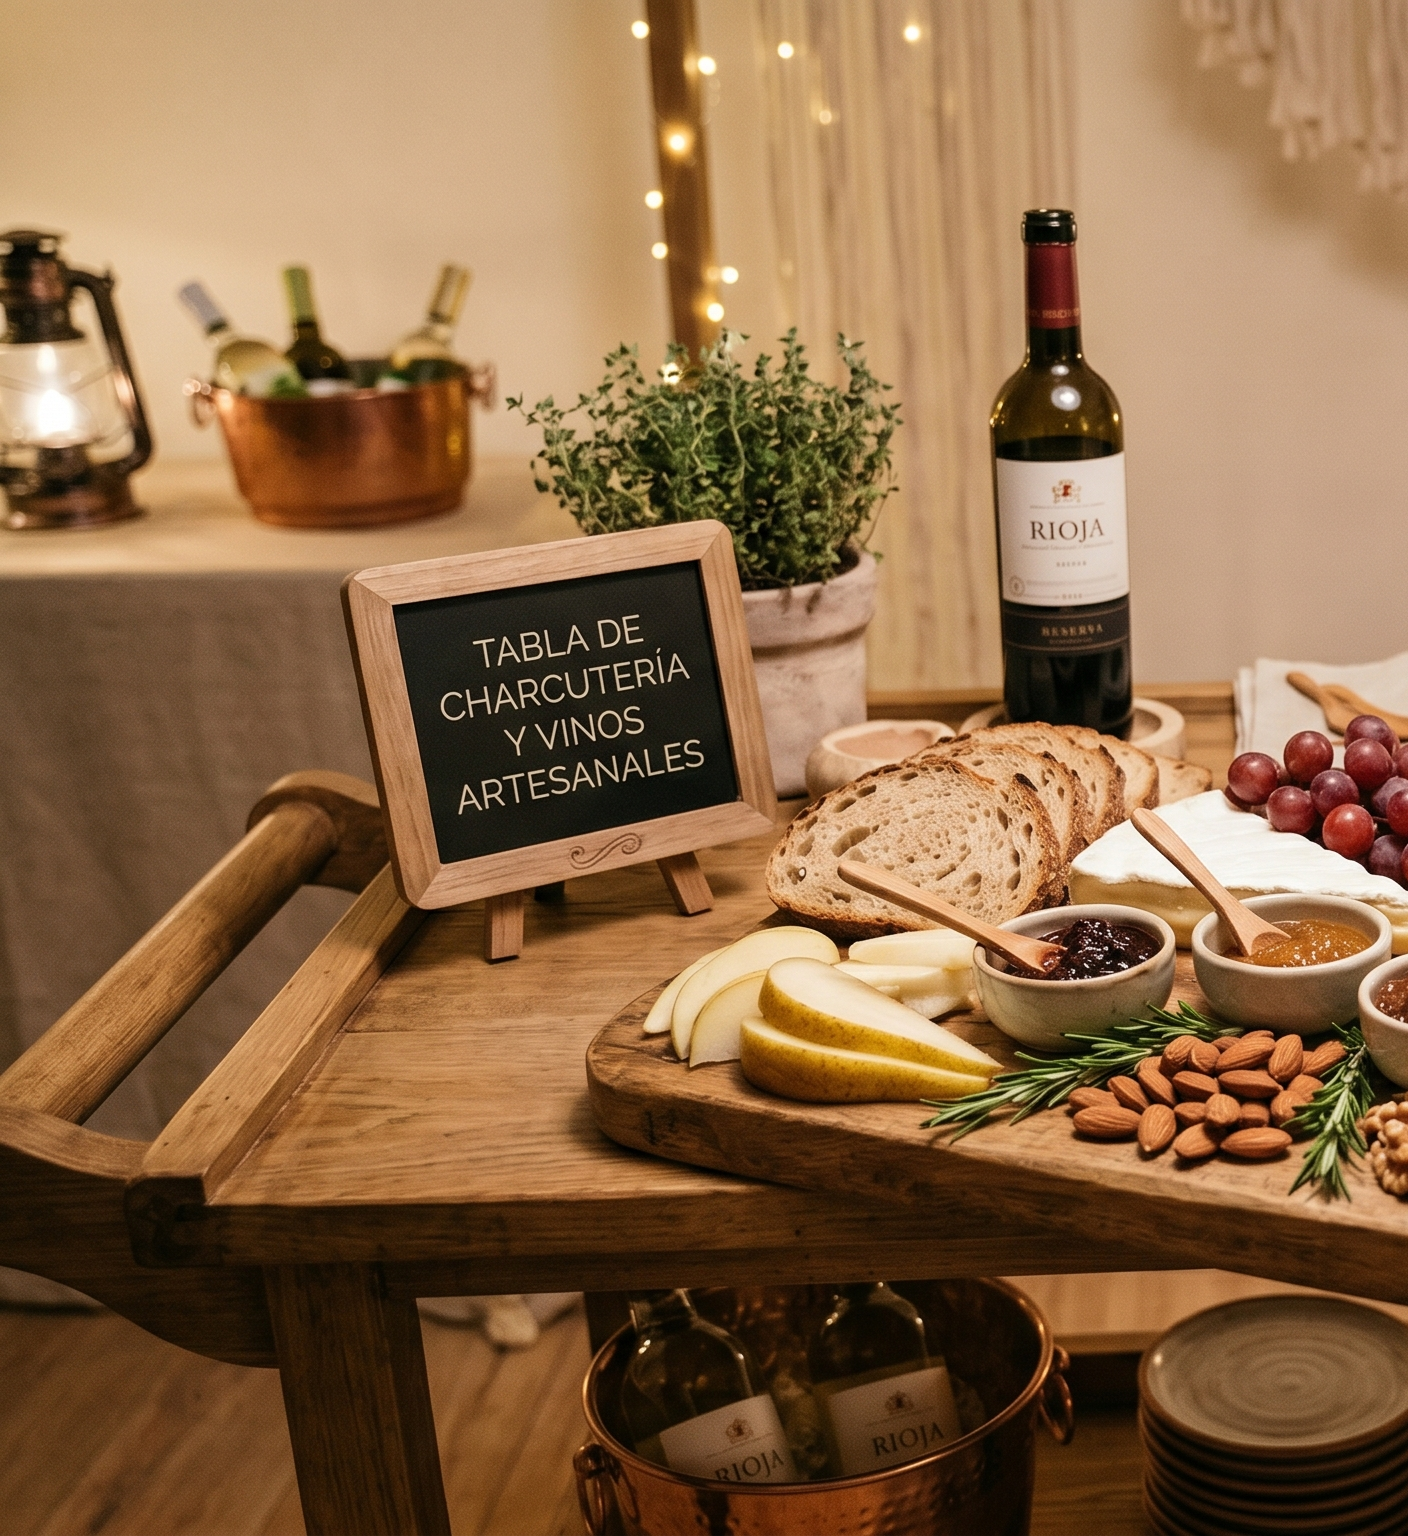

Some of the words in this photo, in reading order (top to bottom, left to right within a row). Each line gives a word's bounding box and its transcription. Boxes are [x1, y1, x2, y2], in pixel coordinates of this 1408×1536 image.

[1030, 518, 1105, 543] RIOJA
[473, 624, 589, 668] TABLA
[597, 614, 644, 649] DE
[1041, 623, 1103, 637] RESERVA
[440, 648, 691, 722] CHARCUTERÍA
[504, 726, 527, 757] Y
[535, 706, 646, 751] VINOS
[458, 739, 705, 816] ARTESANALES
[872, 1422, 944, 1456] RIOJA
[715, 1449, 784, 1481] RIOJA
